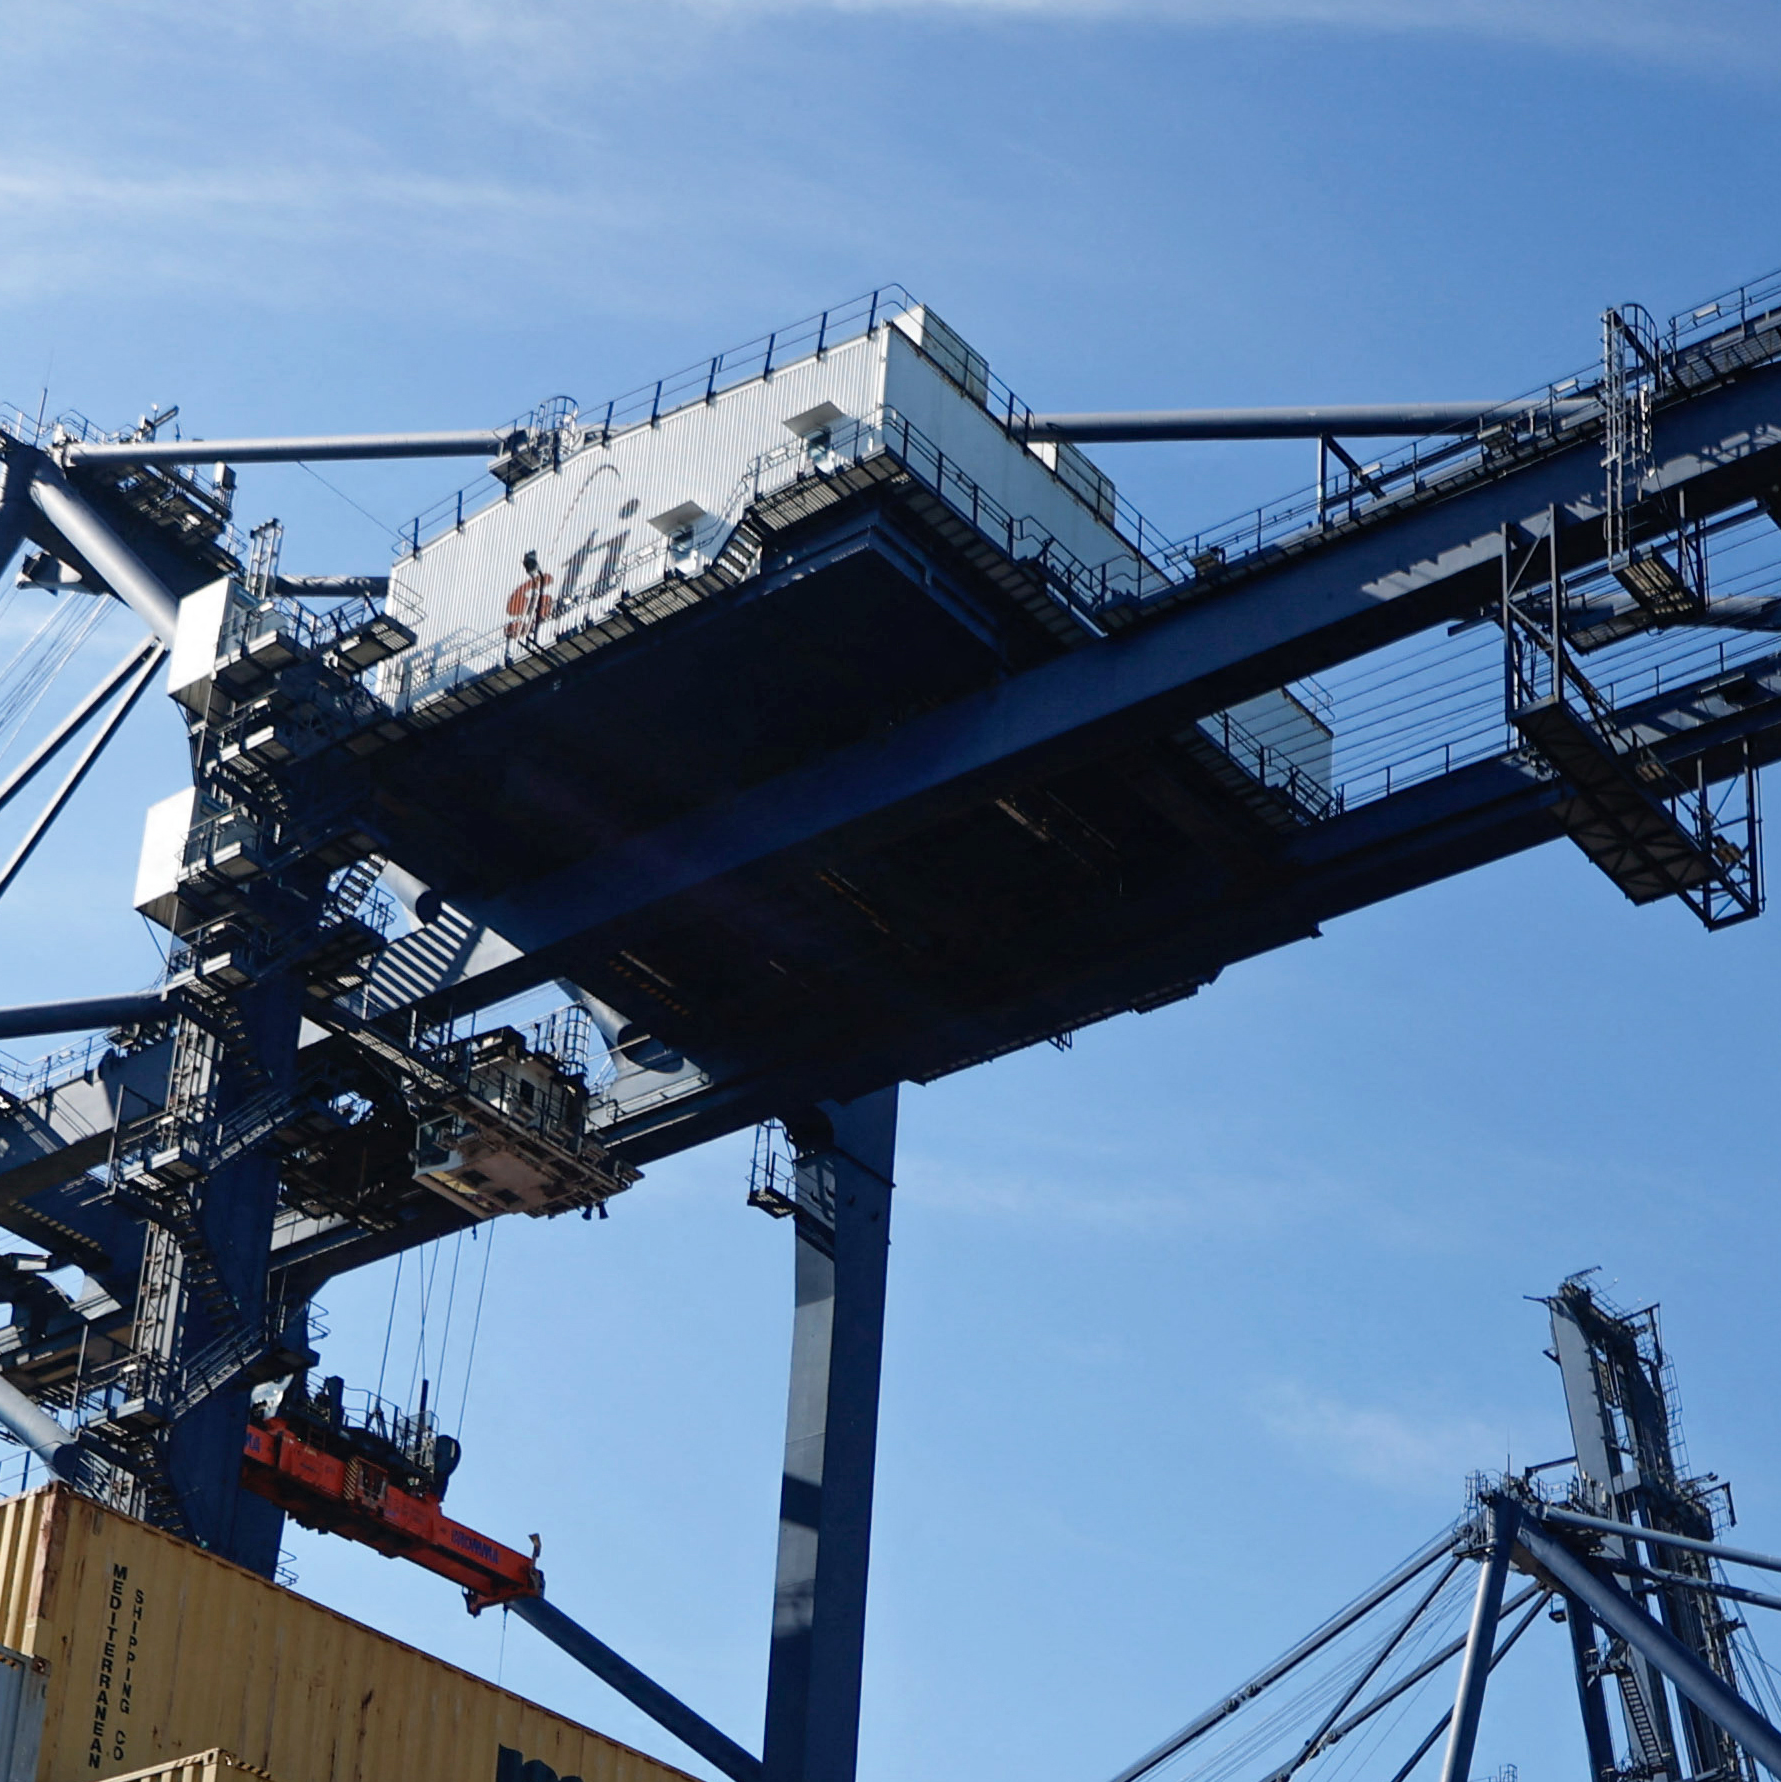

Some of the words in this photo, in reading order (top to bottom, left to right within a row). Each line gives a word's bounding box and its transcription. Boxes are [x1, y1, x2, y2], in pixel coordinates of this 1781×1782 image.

[506, 497, 639, 640] sti
[88, 1563, 128, 1769] MEDITERRANEAN
[119, 1589, 145, 1714] SHIPPING
[113, 1731, 126, 1761] CO
